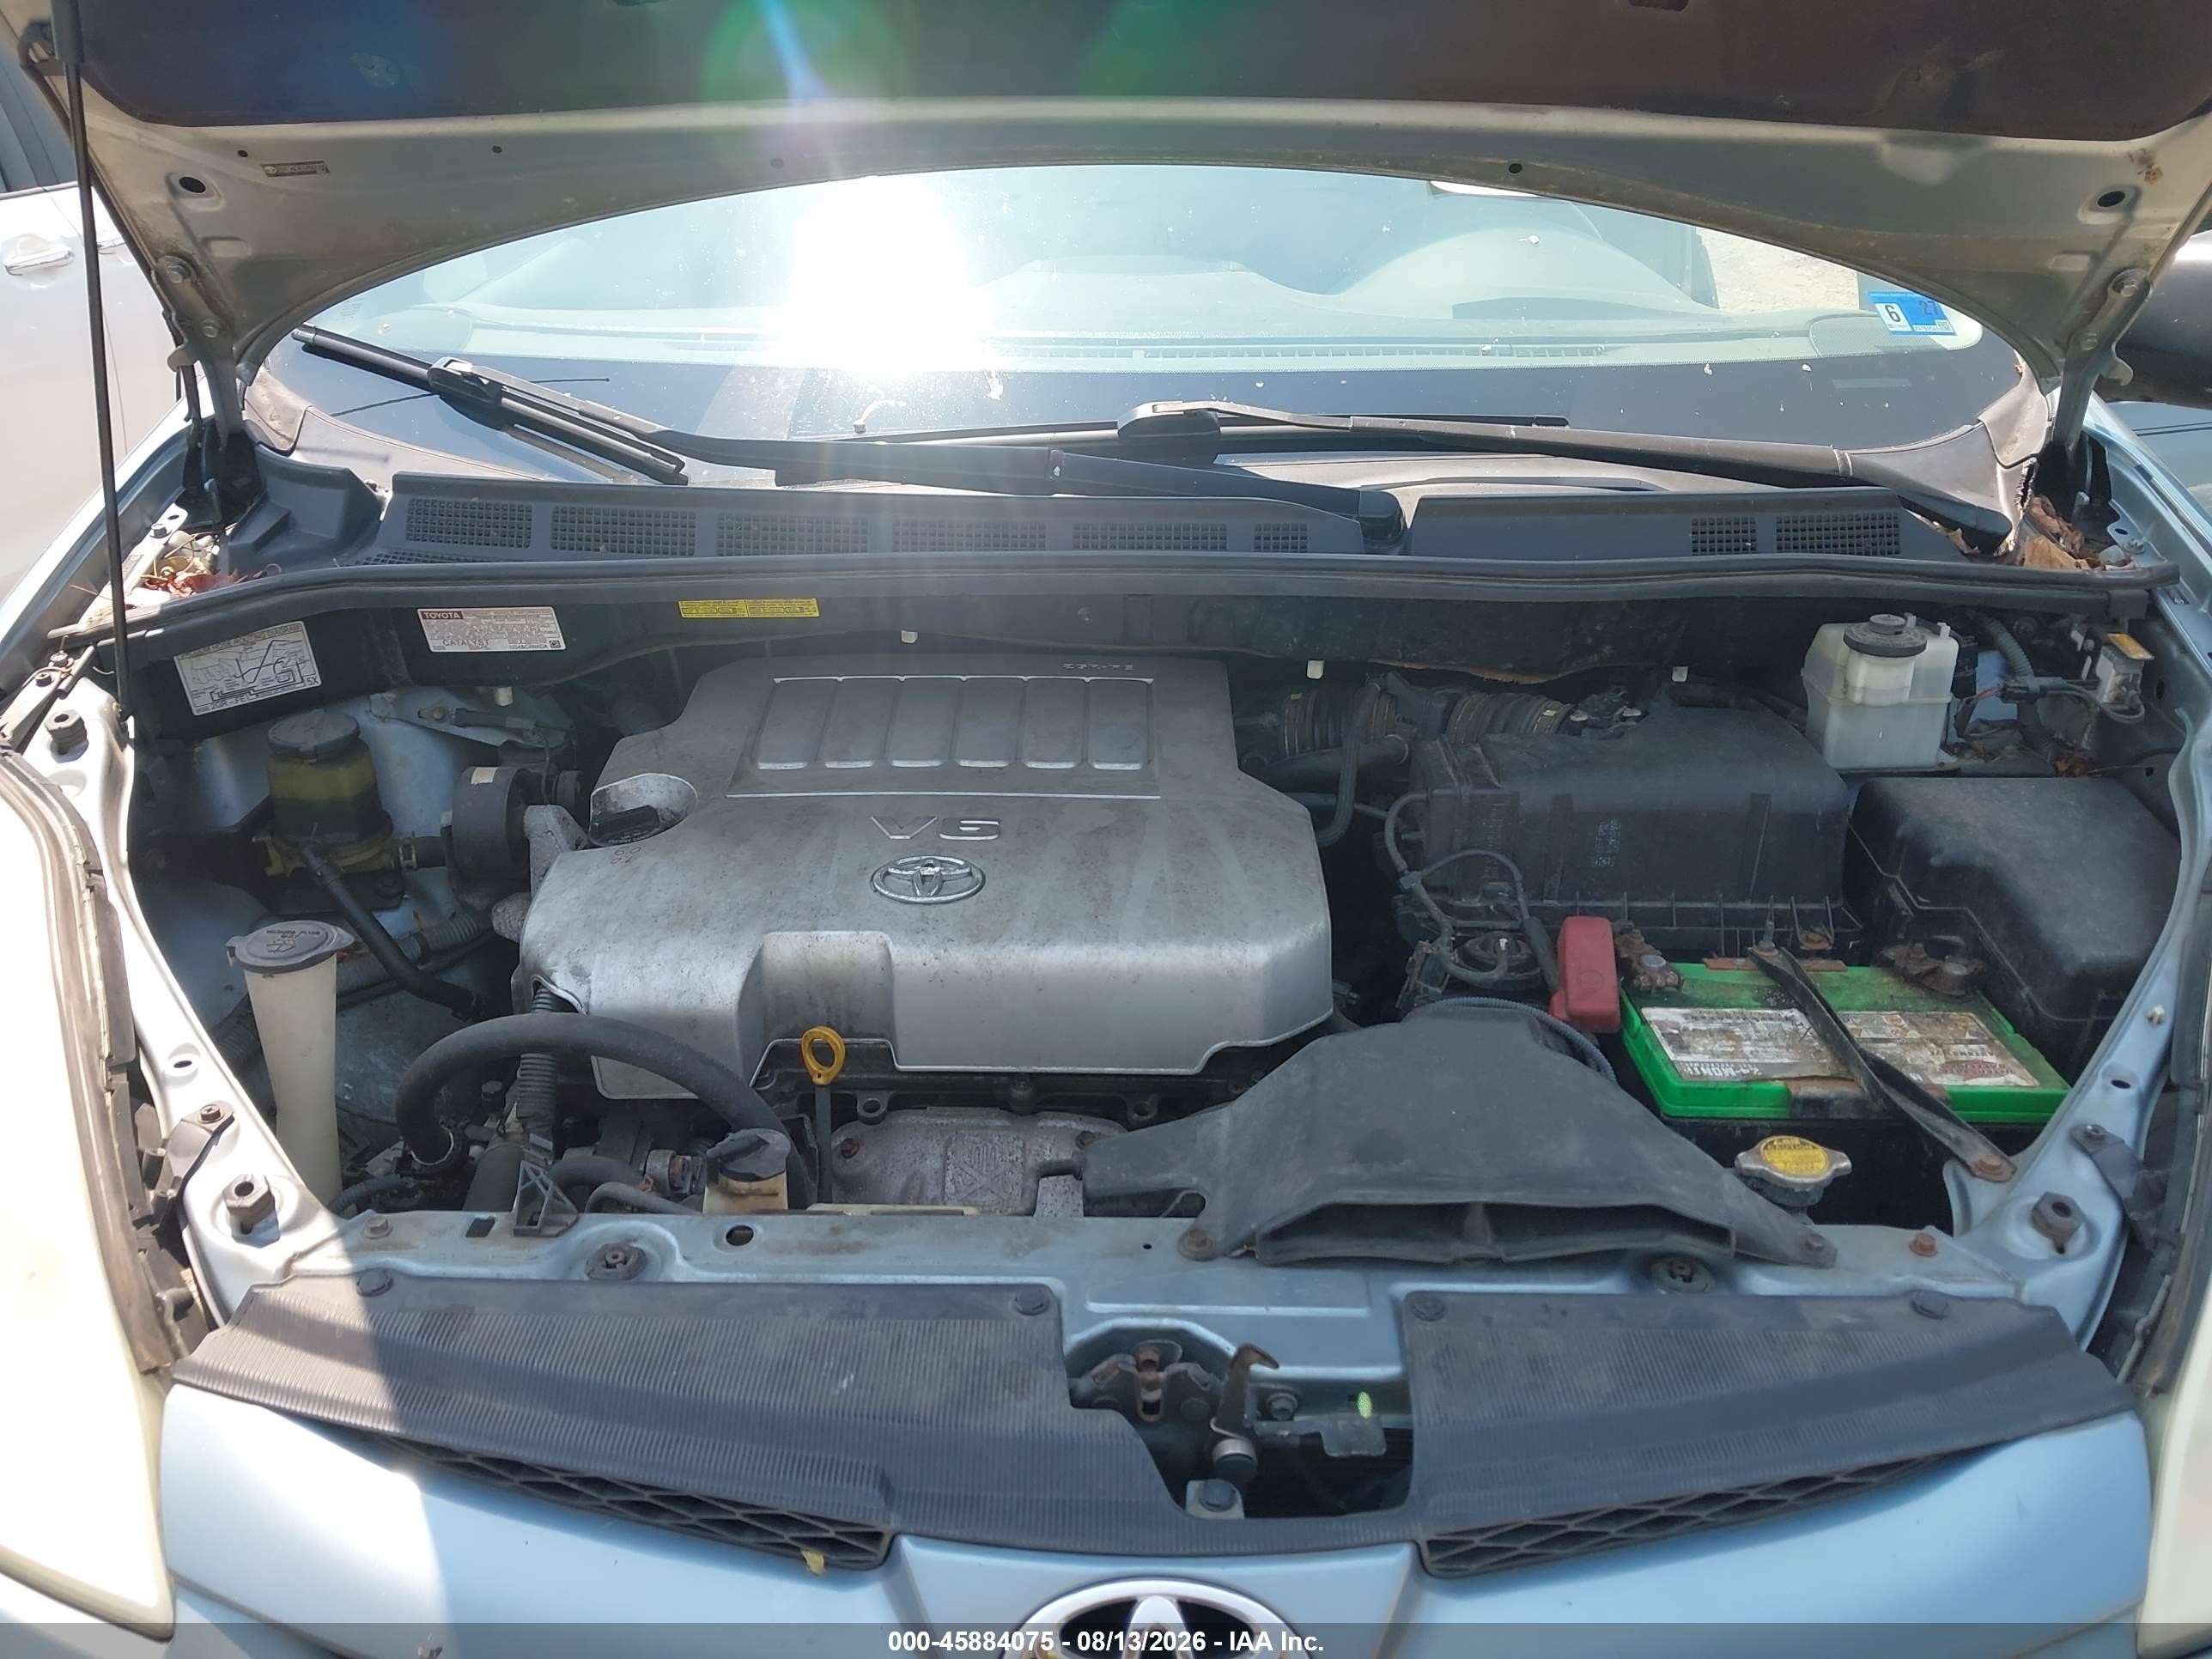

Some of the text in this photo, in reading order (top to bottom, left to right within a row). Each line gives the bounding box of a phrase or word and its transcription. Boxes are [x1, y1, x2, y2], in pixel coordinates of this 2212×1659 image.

[1884, 305, 1901, 322] 6
[1918, 301, 1939, 316] 27
[423, 611, 462, 620] TOYOTA
[441, 638, 489, 647] CATALYST
[307, 676, 319, 686] 5X
[869, 815, 1001, 841] V6
